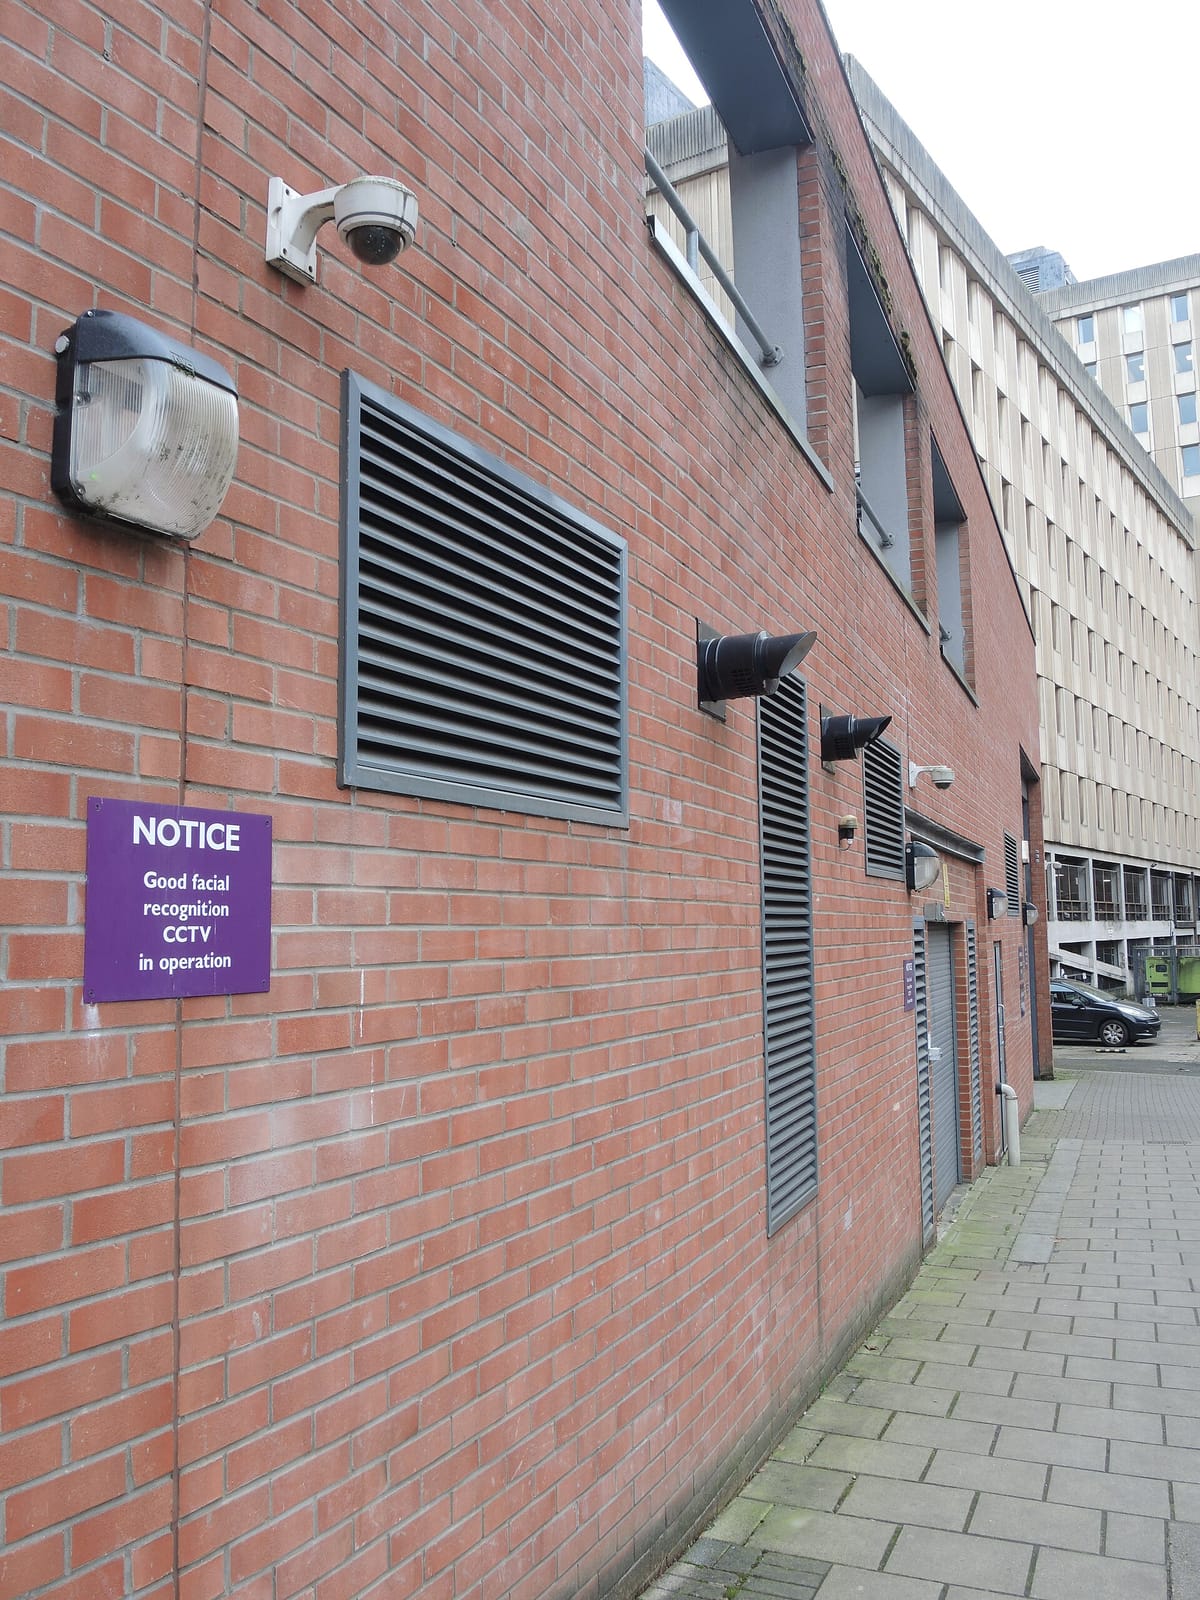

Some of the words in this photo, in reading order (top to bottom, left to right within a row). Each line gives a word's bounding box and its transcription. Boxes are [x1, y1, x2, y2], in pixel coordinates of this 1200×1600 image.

[132, 815, 241, 852] NOTICE
[143, 871, 187, 890] Good
[191, 873, 230, 891] facial
[143, 900, 229, 921] recognition
[163, 925, 211, 943] CCTV
[139, 953, 153, 971] in
[159, 952, 231, 975] operation
